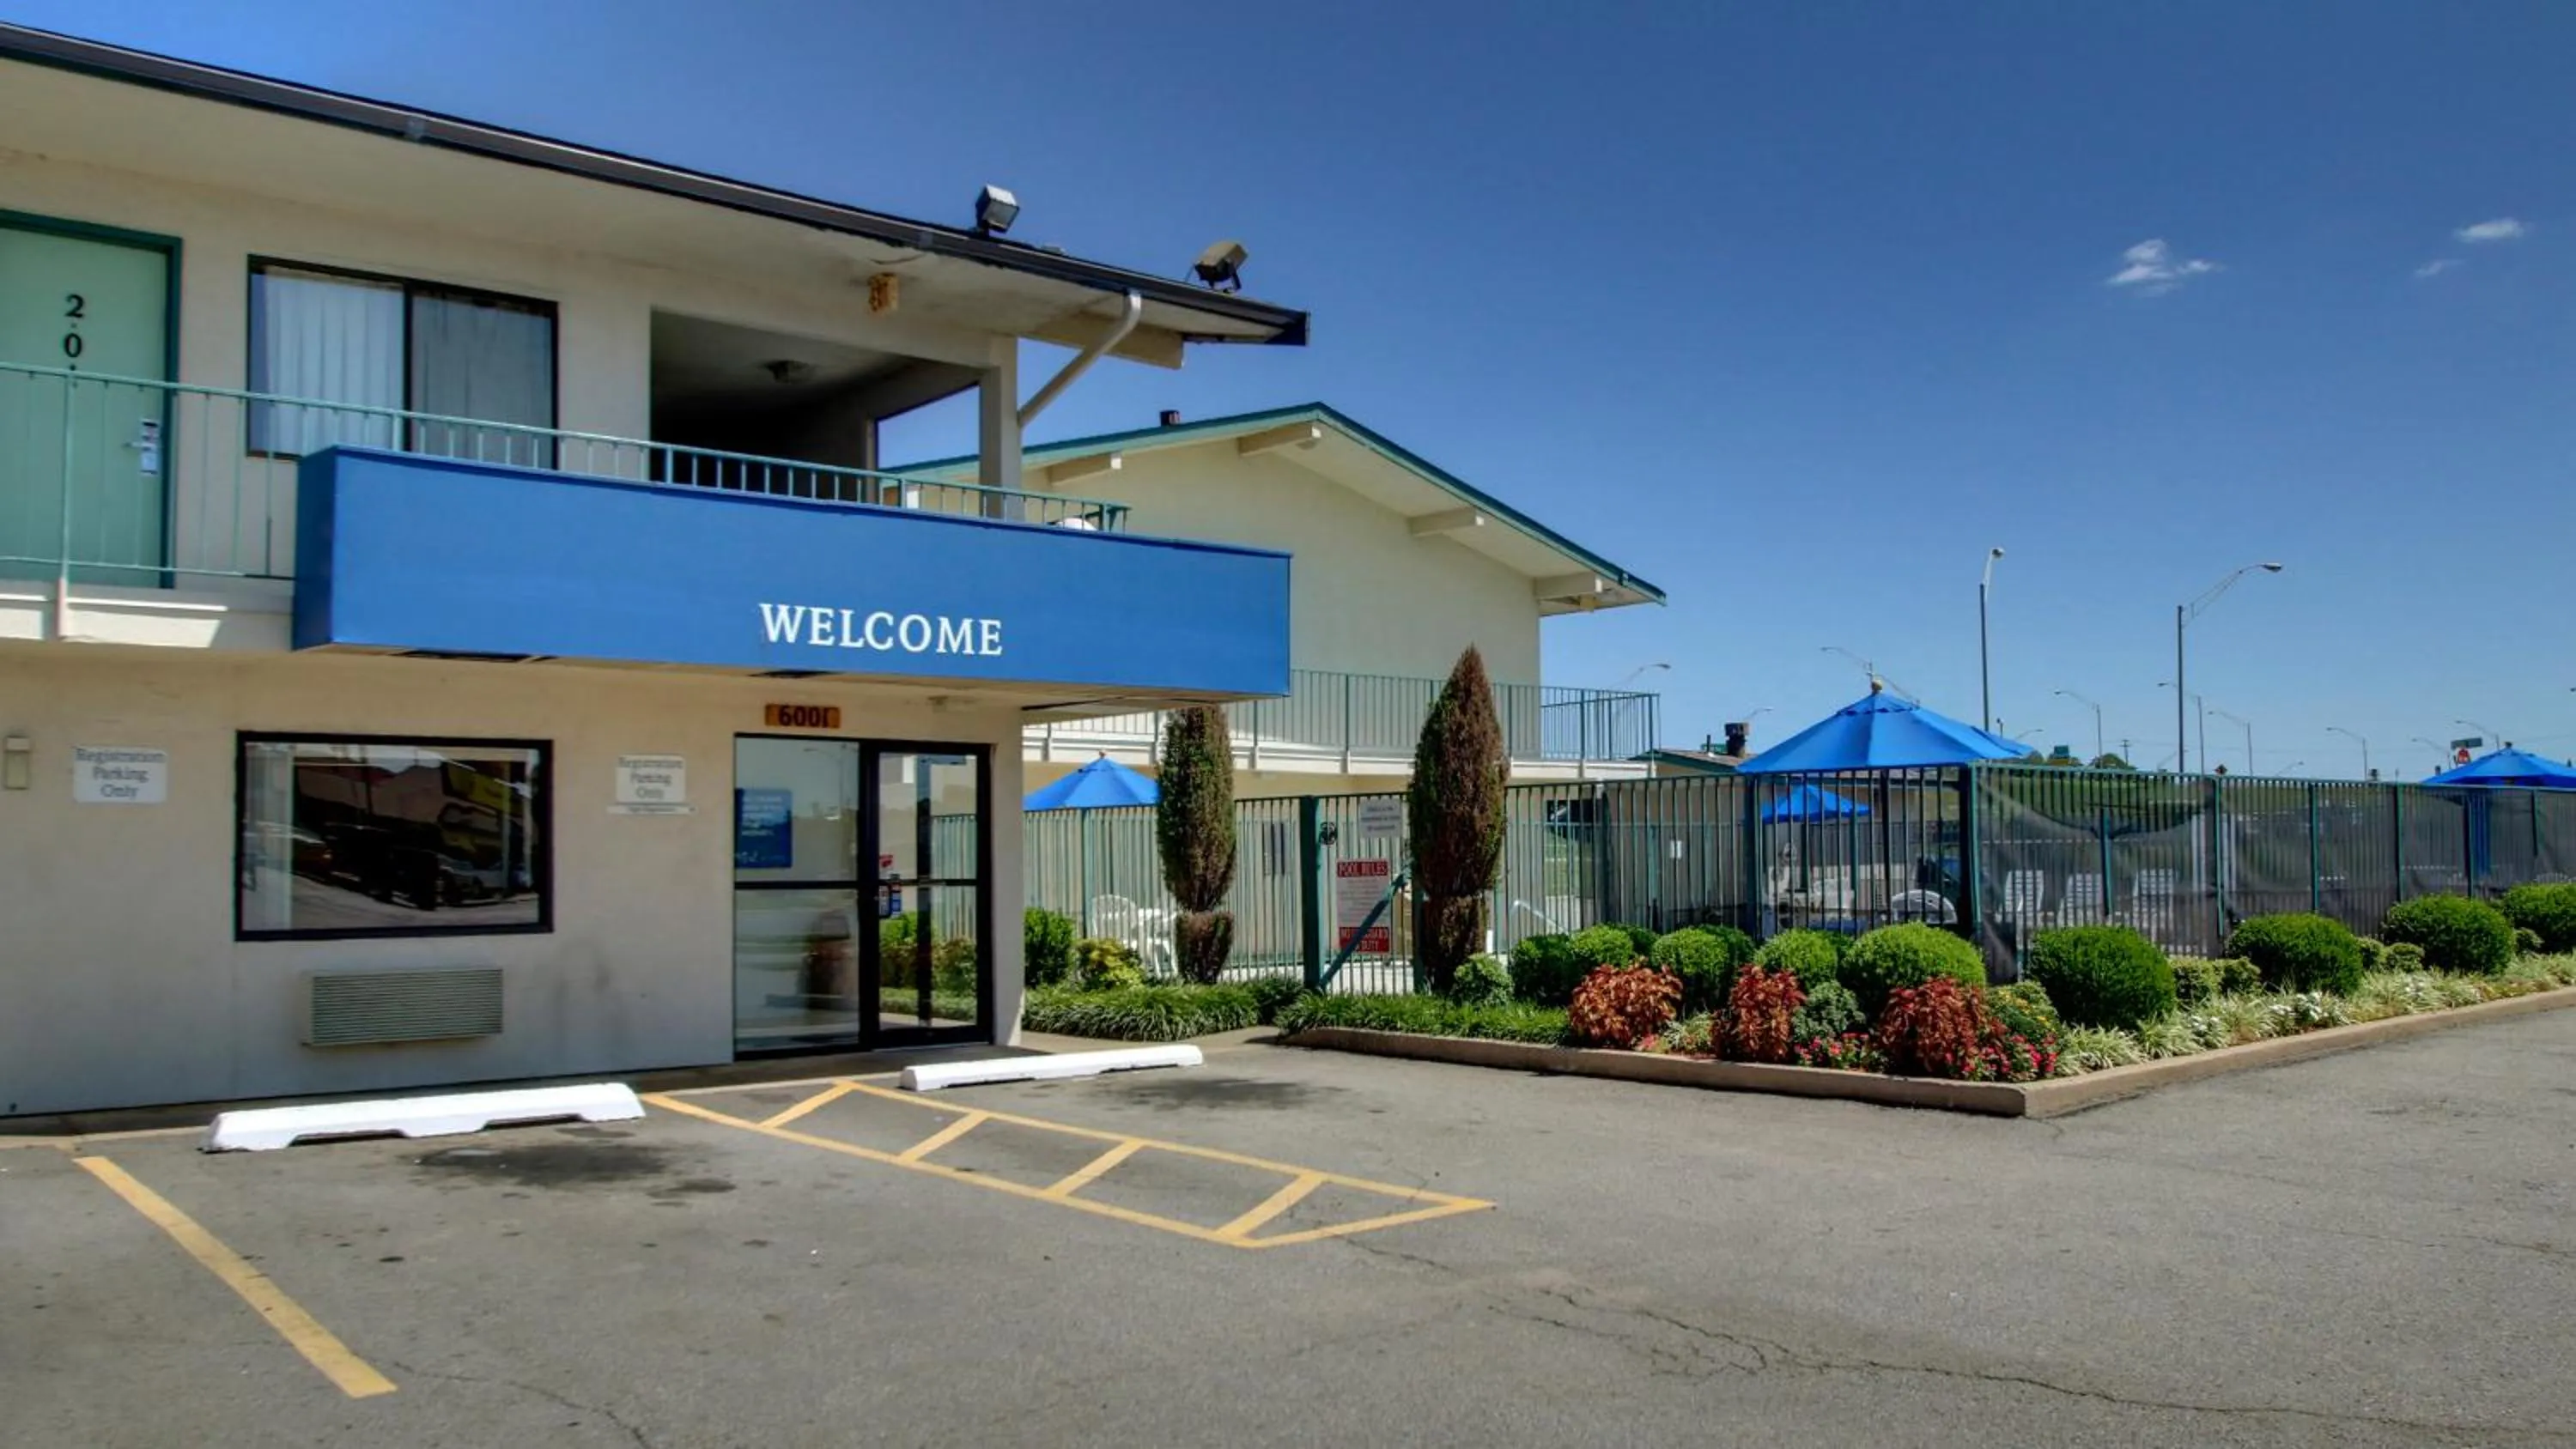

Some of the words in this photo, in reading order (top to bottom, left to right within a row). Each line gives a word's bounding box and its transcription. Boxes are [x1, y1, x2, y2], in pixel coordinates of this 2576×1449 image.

[759, 603, 1003, 656] WELCOME
[778, 705, 829, 729] 6001
[93, 766, 149, 784] Parking
[100, 784, 139, 800] Only
